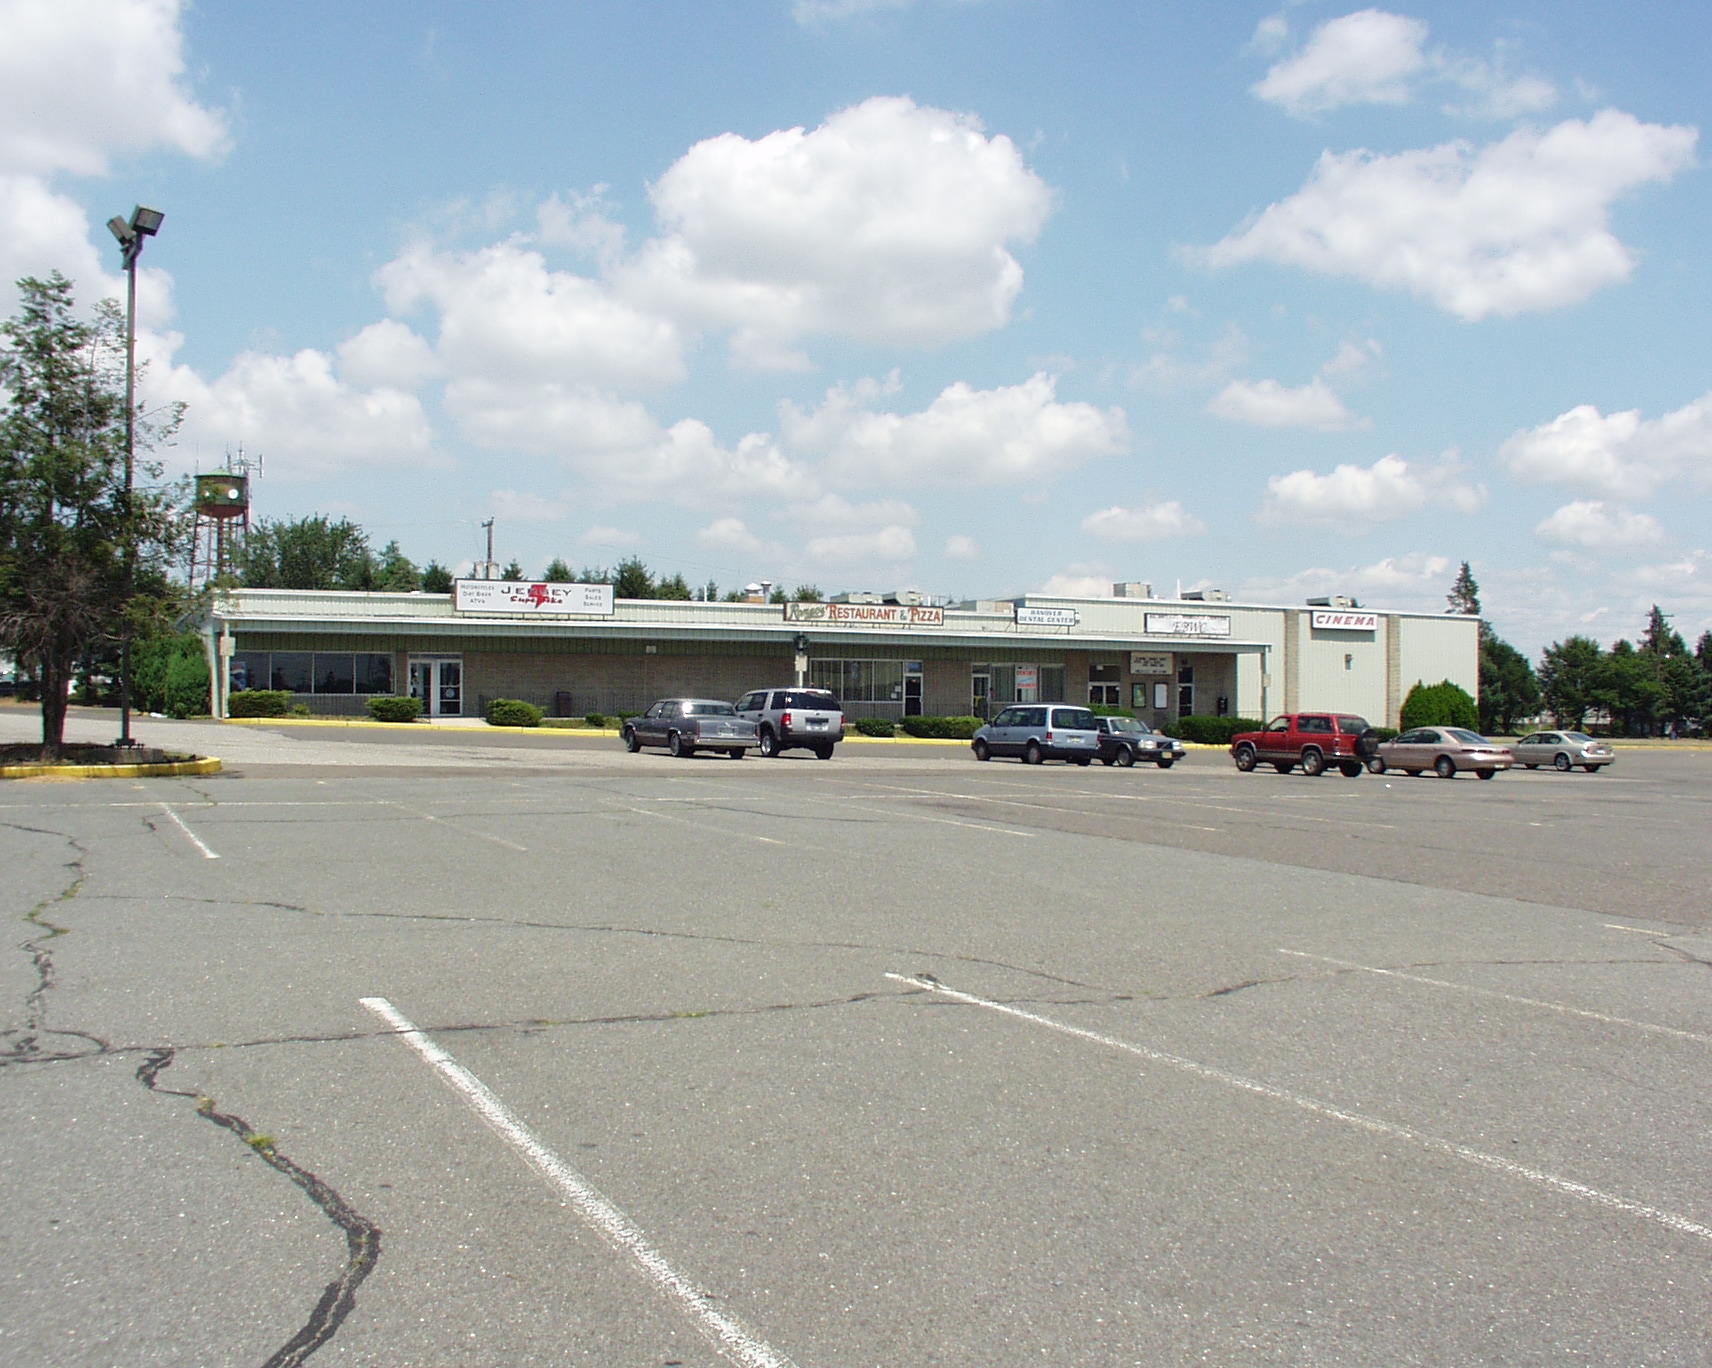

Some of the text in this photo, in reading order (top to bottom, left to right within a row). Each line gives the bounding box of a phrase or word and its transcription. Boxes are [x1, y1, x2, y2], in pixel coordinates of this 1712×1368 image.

[501, 585, 572, 597] JERSEY
[826, 604, 897, 621] RESTAURANT
[899, 610, 908, 621] &
[908, 606, 941, 623] PIZZA
[1047, 616, 1073, 624] CENTER
[1316, 614, 1375, 626] CINEMA
